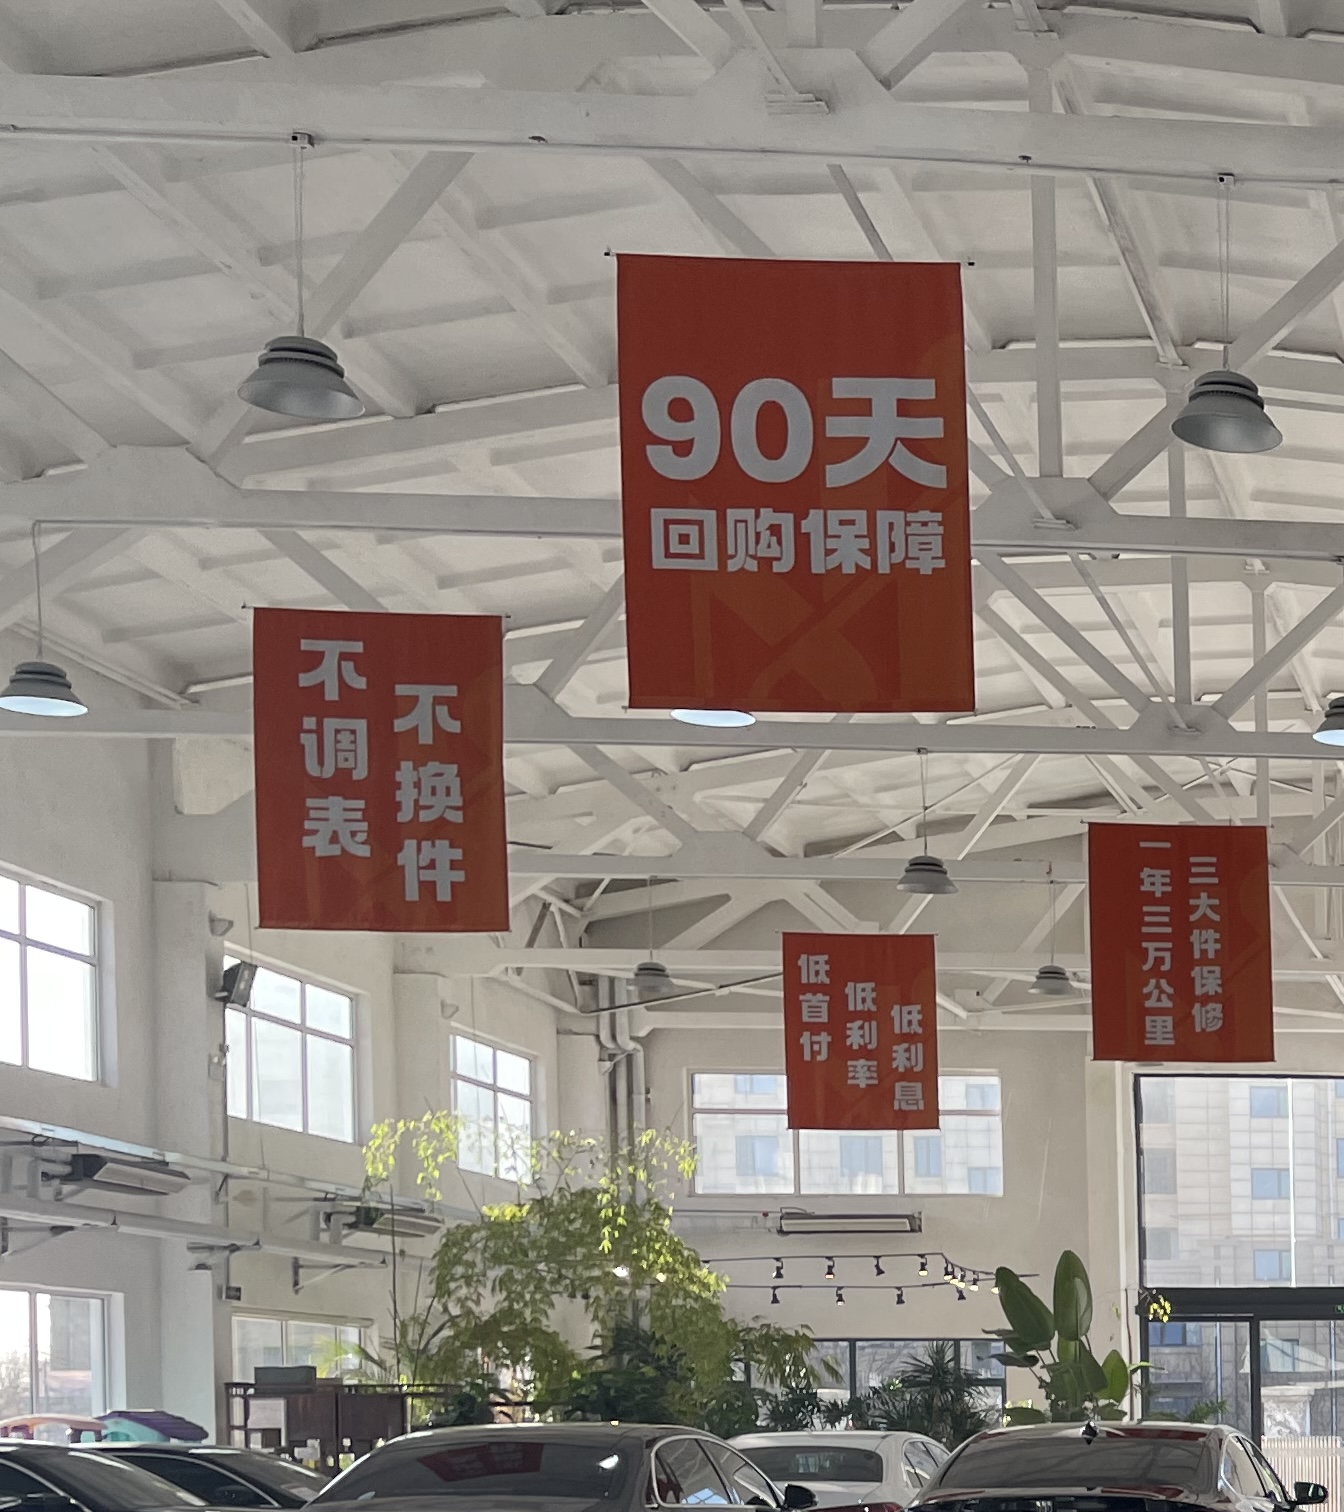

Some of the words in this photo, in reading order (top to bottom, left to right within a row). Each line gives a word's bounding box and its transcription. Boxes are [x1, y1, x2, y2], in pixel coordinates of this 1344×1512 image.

[641, 375, 948, 489] 90天
[650, 507, 946, 575] 回购保障
[298, 638, 371, 859] 不调表
[393, 683, 466, 903] 不换件
[1139, 840, 1176, 1047] 一年三万公里
[1188, 856, 1224, 1033] 三大件保修
[797, 953, 832, 1063] 低首付
[844, 981, 879, 1090] 低利率
[890, 1004, 925, 1112] 低利息
